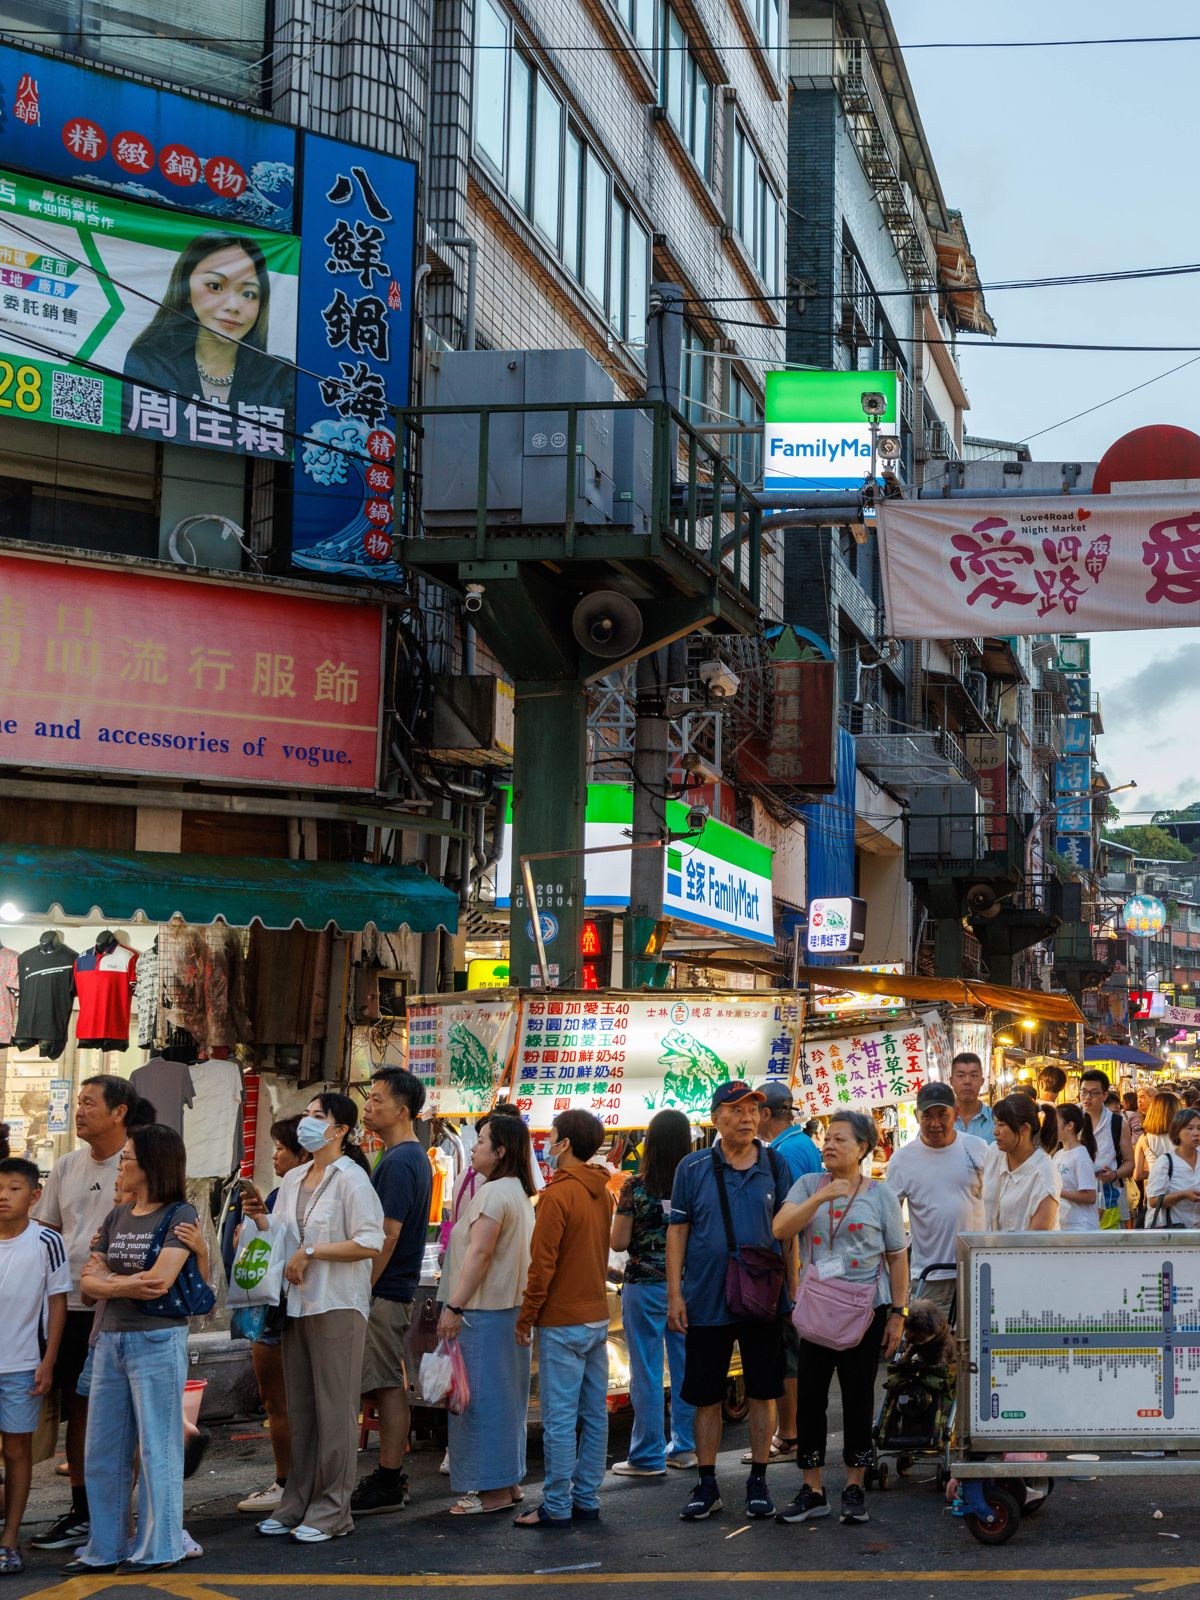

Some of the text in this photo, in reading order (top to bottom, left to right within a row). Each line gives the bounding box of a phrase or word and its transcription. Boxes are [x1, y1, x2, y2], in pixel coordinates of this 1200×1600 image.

[16, 76, 41, 127] 火鍋
[67, 124, 244, 195] 精緻鍋物
[28, 199, 115, 229] 歡迎同業合作
[41, 257, 68, 276] 店面
[4, 293, 79, 326] 委託銷售
[1021, 513, 1074, 523] Love4Road
[1022, 524, 1087, 535] Night Market
[34, 718, 81, 740] and
[98, 725, 230, 754] accessories
[242, 736, 267, 757] of
[282, 743, 353, 767] vogue.
[516, 897, 573, 908] G0804
[686, 858, 760, 922] 全家 FamilyMart
[811, 1049, 835, 1108] 珍珠奶茶
[828, 1043, 852, 1104] 金桔檸檬
[863, 1039, 888, 1099] 甘蔗汁
[880, 1033, 909, 1097] 青草茶
[235, 1267, 266, 1281] SHOP
